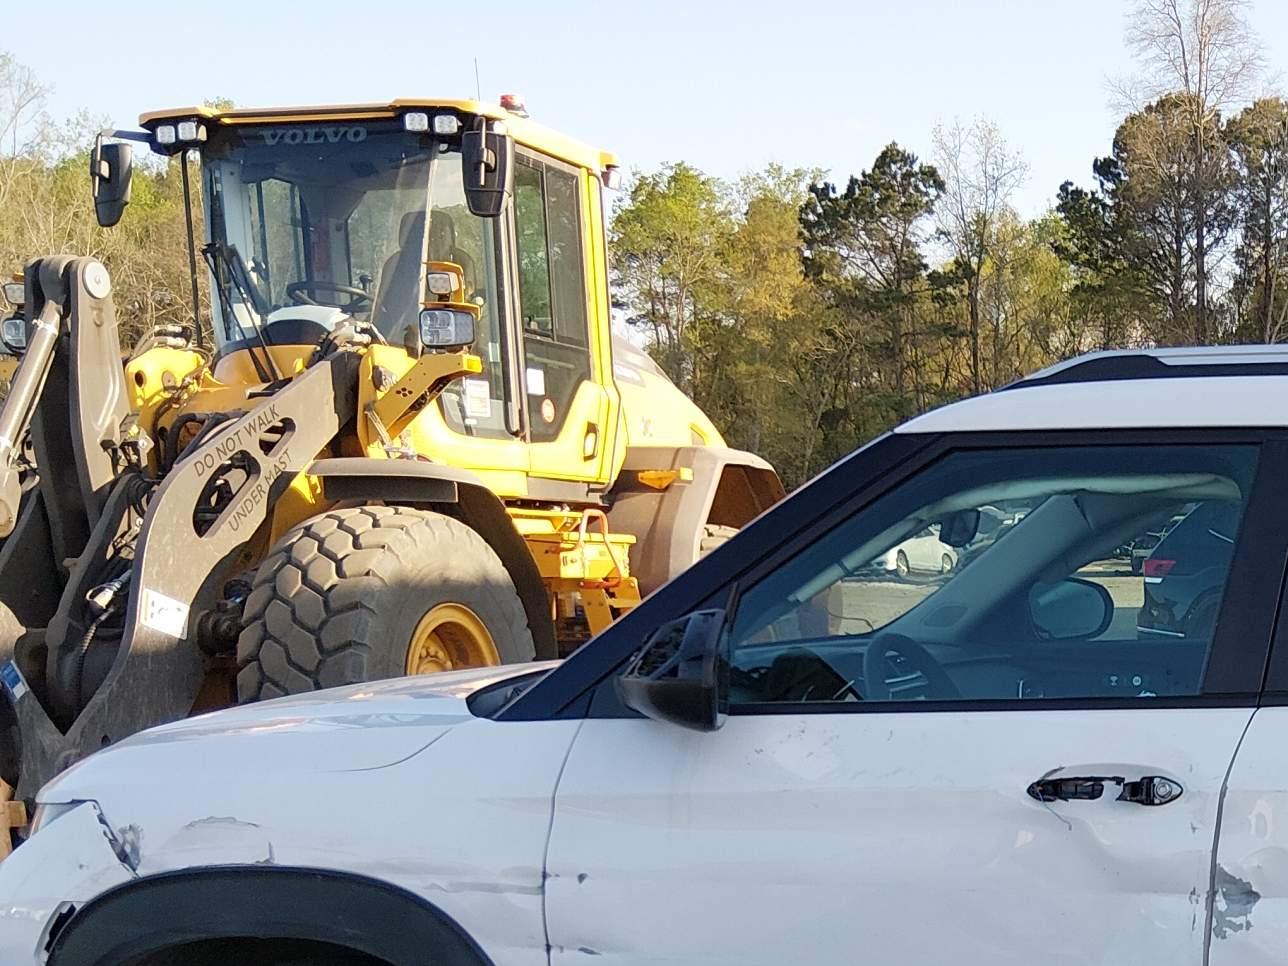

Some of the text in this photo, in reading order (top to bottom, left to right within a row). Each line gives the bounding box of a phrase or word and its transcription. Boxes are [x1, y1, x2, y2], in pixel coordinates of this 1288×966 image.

[258, 126, 367, 145] VOLVO
[193, 404, 280, 477] DO NOT WALK
[228, 448, 292, 531] UNDER MAST
